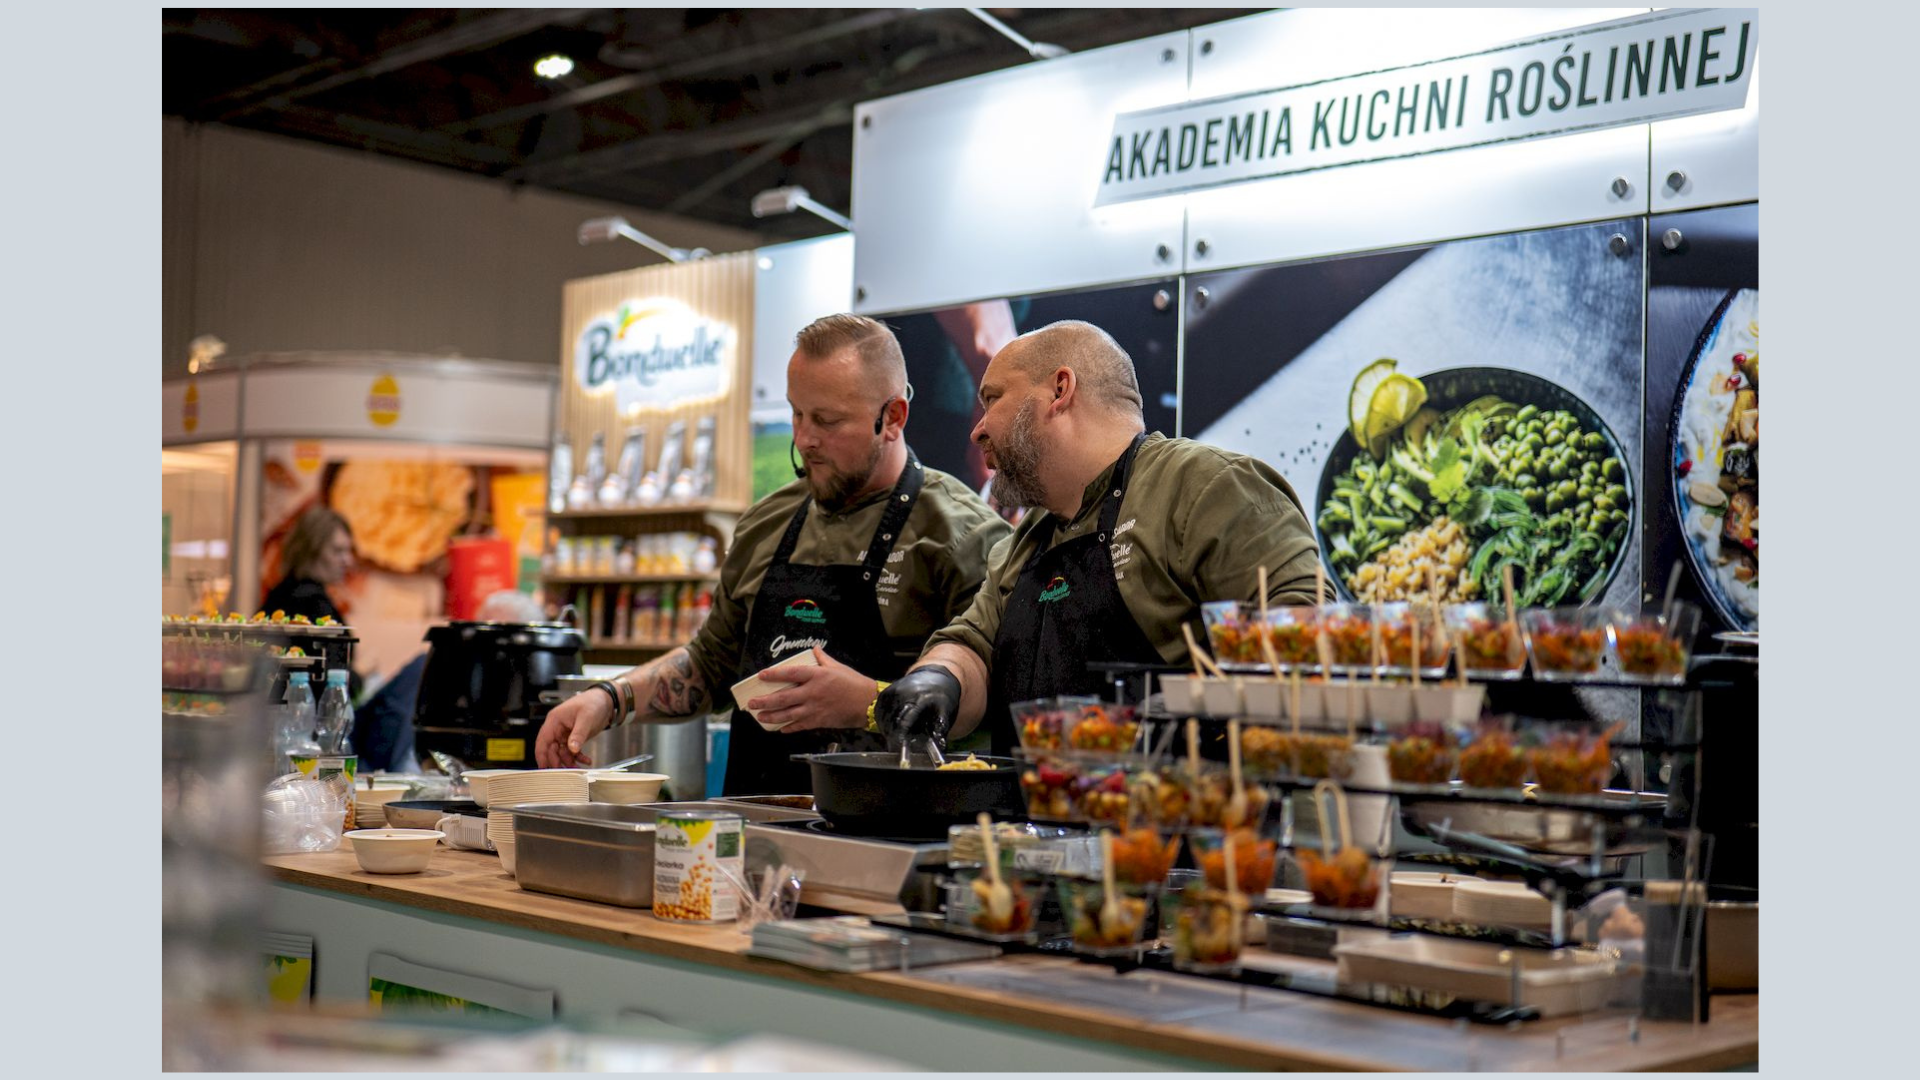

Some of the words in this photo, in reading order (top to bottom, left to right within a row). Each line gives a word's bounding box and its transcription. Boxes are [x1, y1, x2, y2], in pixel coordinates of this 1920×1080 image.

[1103, 106, 1293, 184] AKADEMIA
[1309, 74, 1469, 151] KUCHNI
[1485, 21, 1751, 123] ROŚLINNEJ
[586, 325, 720, 387] Bonduelle
